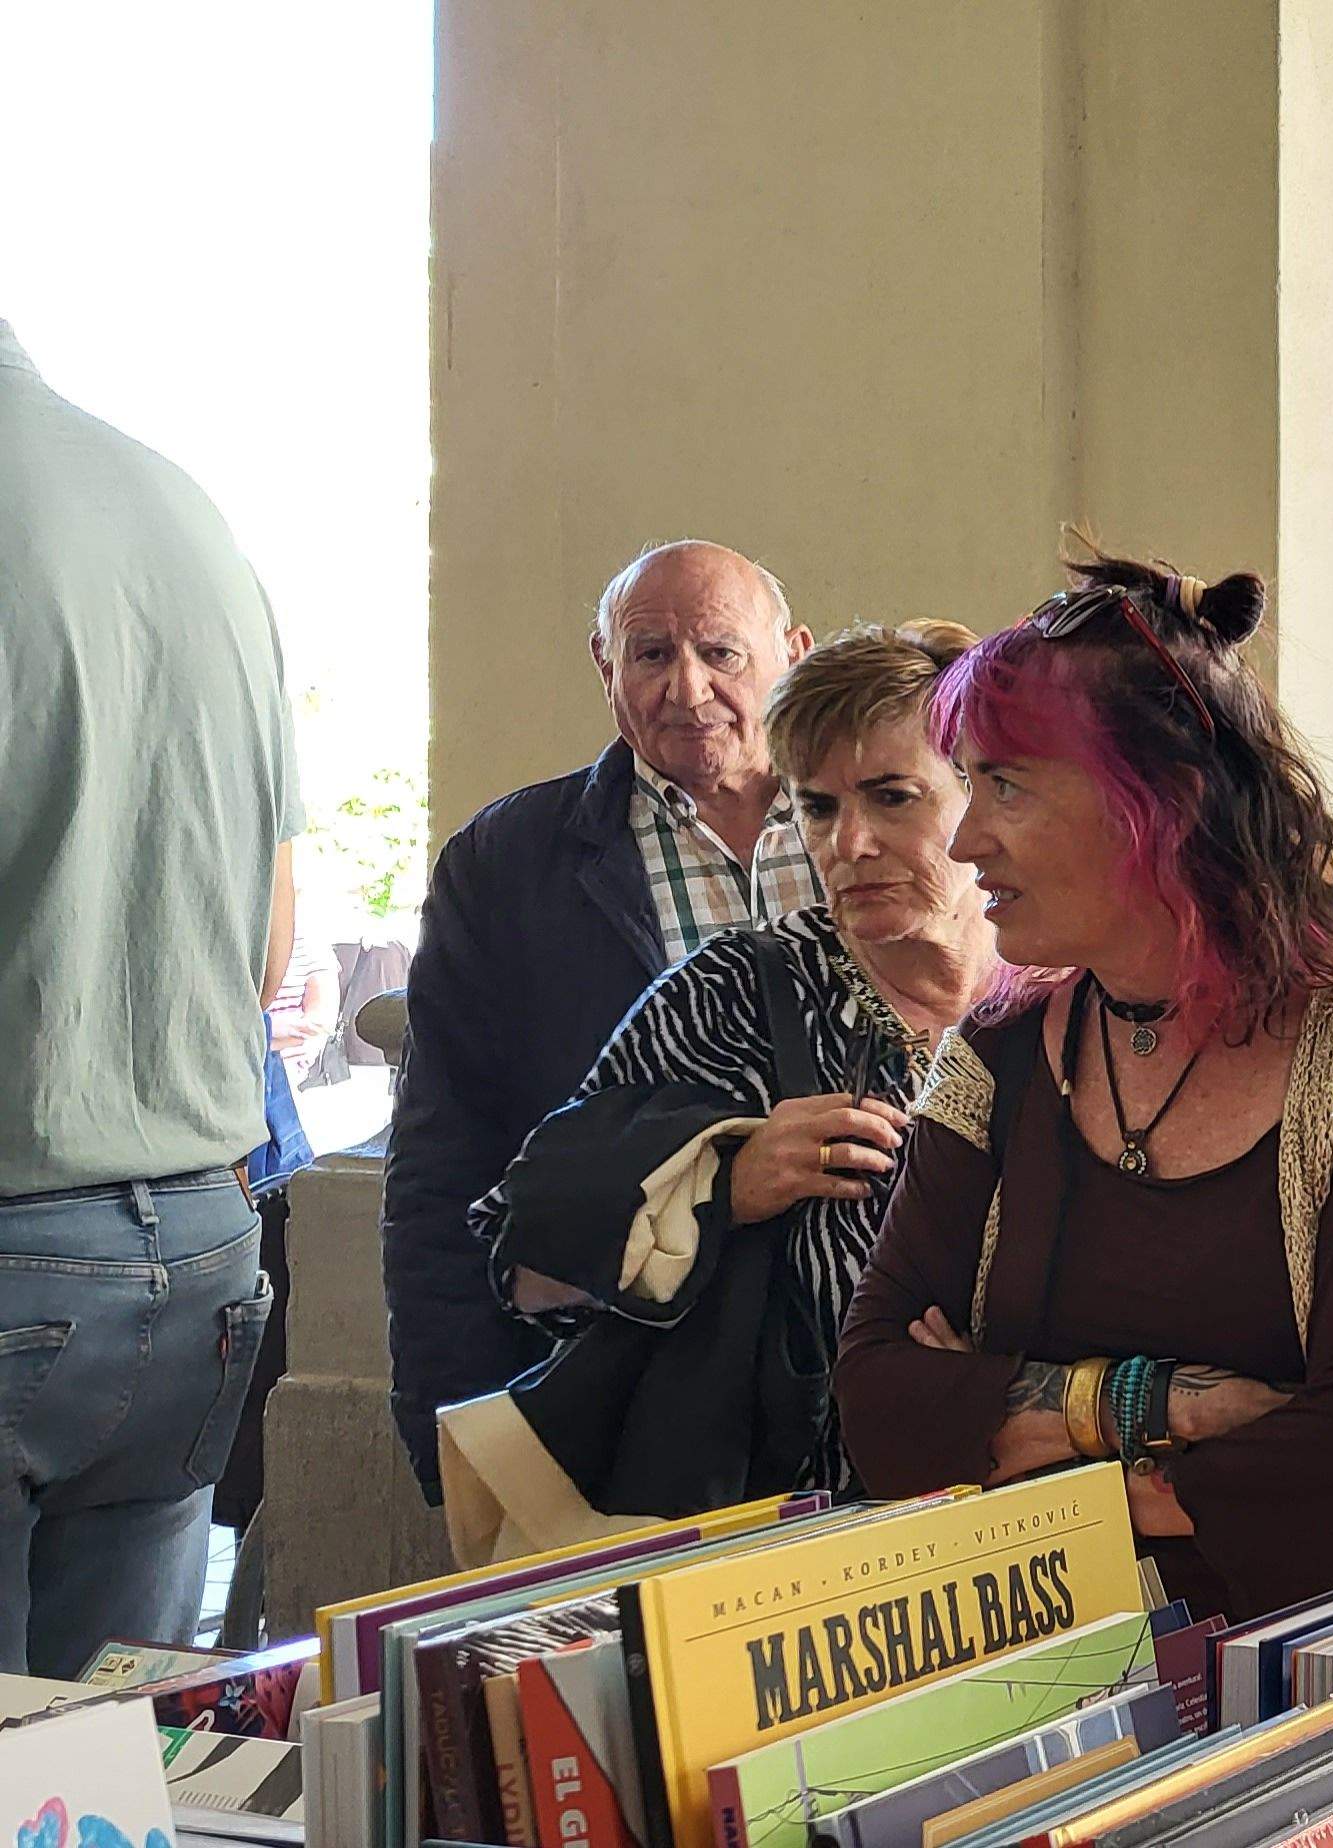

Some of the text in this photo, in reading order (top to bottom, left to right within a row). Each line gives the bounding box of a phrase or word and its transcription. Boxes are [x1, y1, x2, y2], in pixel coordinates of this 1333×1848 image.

[712, 1500, 1080, 1618] MACAN KORDEY VITKOVIĆ
[746, 1548, 1075, 1731] MARSHAL BASS
[551, 1756, 581, 1802] EL
